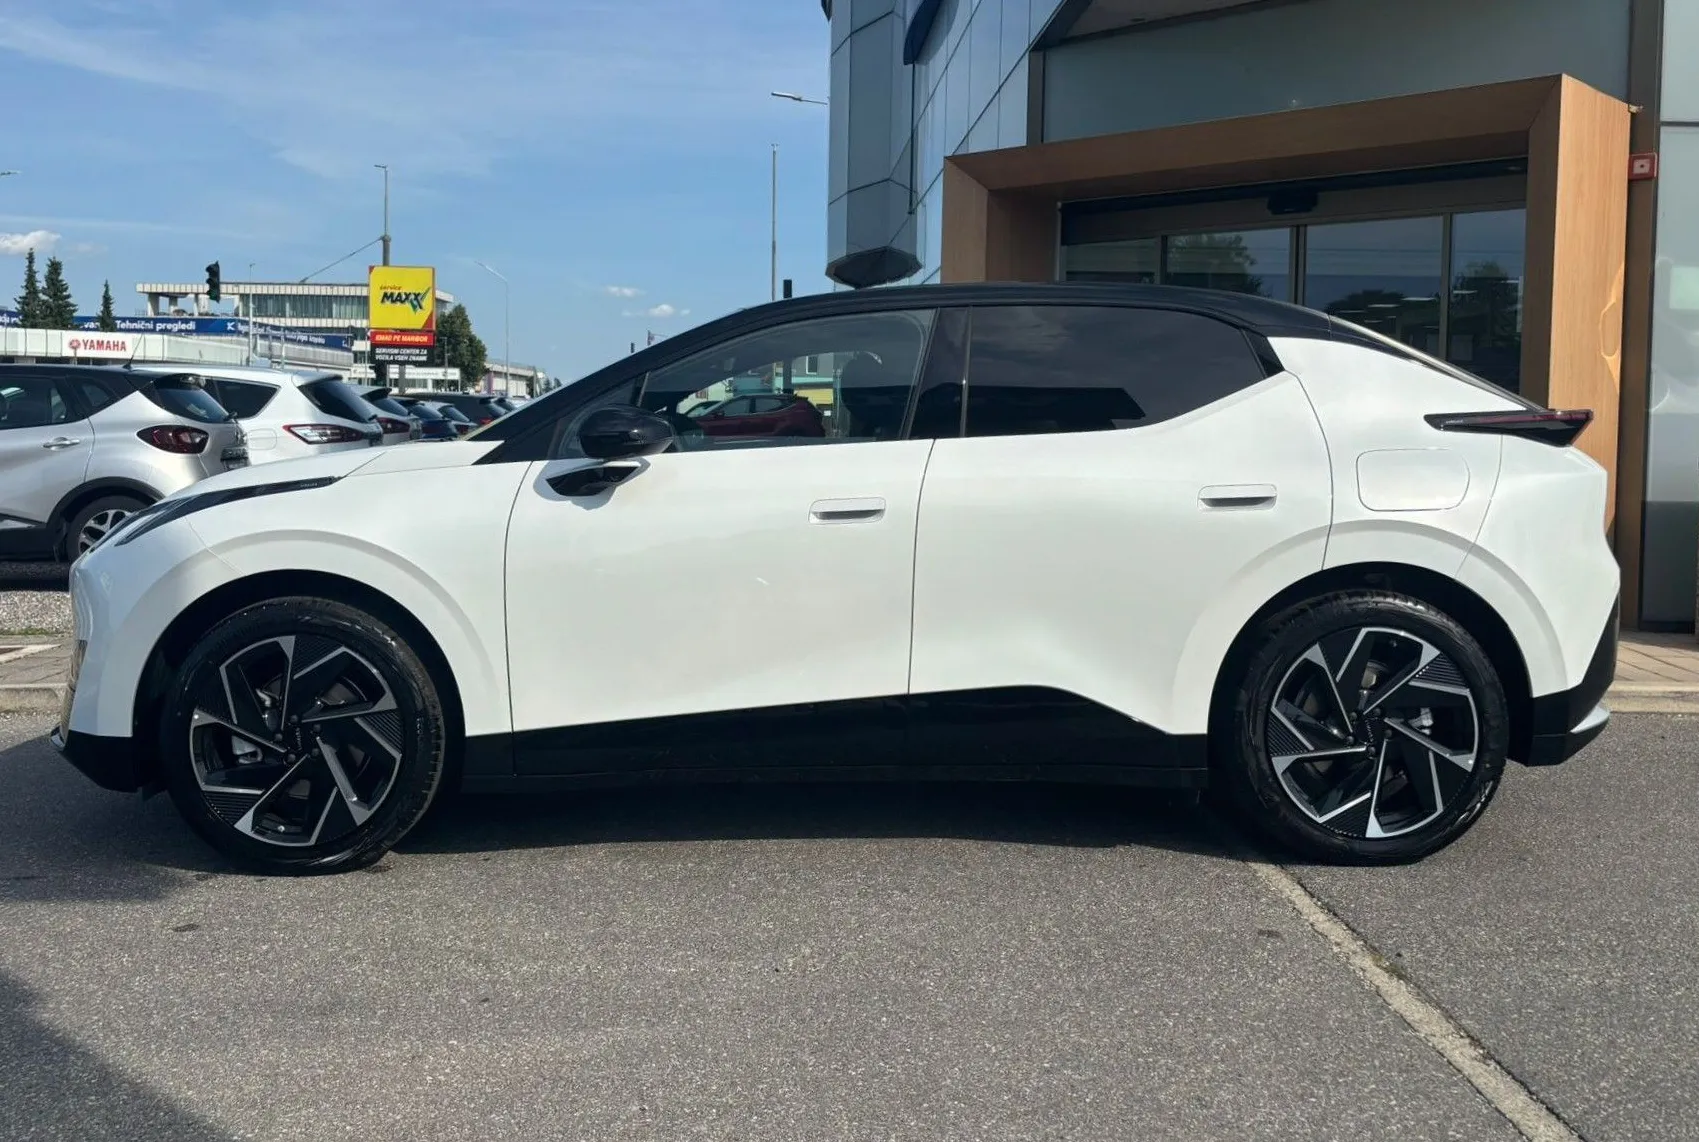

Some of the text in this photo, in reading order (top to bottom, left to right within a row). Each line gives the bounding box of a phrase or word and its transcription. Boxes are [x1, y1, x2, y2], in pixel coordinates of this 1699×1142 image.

[115, 320, 196, 332] Tehnični pregledi
[82, 339, 127, 352] YAMAHA
